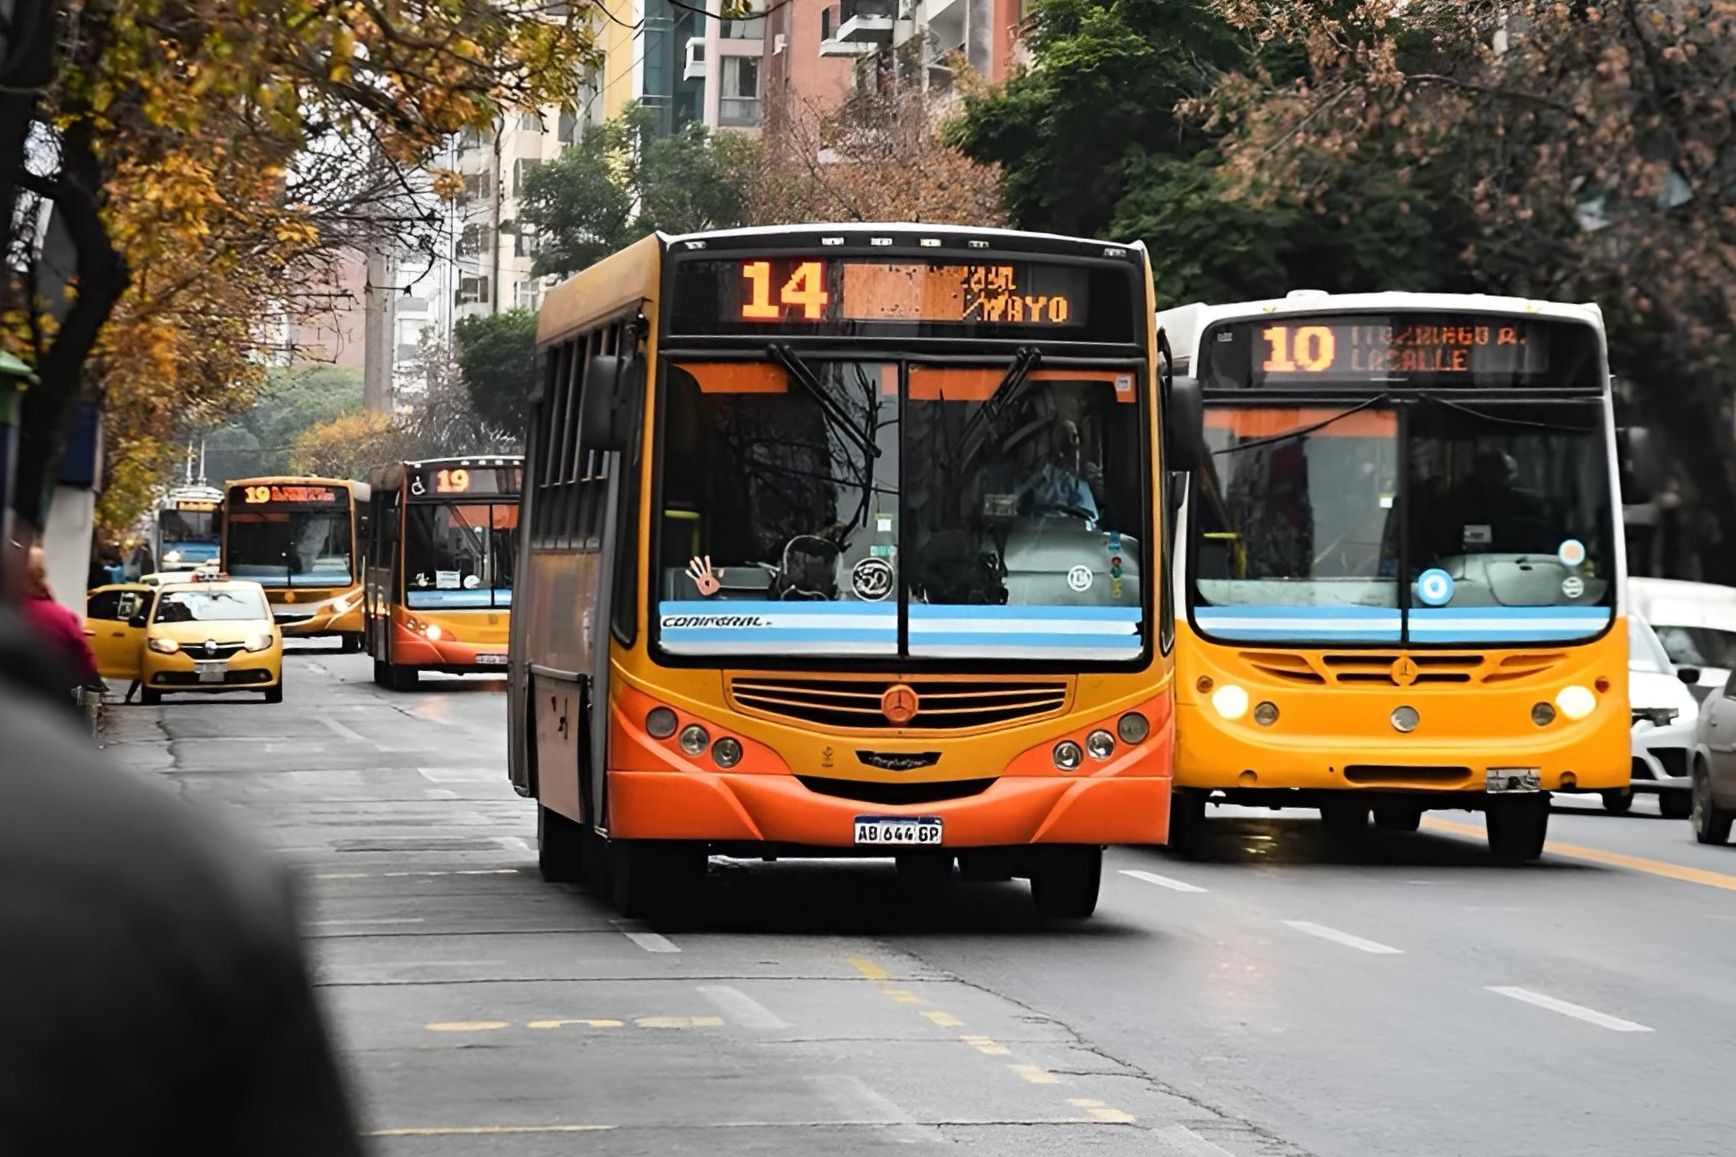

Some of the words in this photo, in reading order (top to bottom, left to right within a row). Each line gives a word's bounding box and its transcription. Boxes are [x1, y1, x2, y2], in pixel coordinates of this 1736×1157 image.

[742, 261, 828, 319] 14
[1262, 325, 1336, 372] 10
[436, 469, 470, 493] 19
[244, 486, 271, 503] 19
[858, 826, 878, 841] AB
[883, 826, 914, 841] 644
